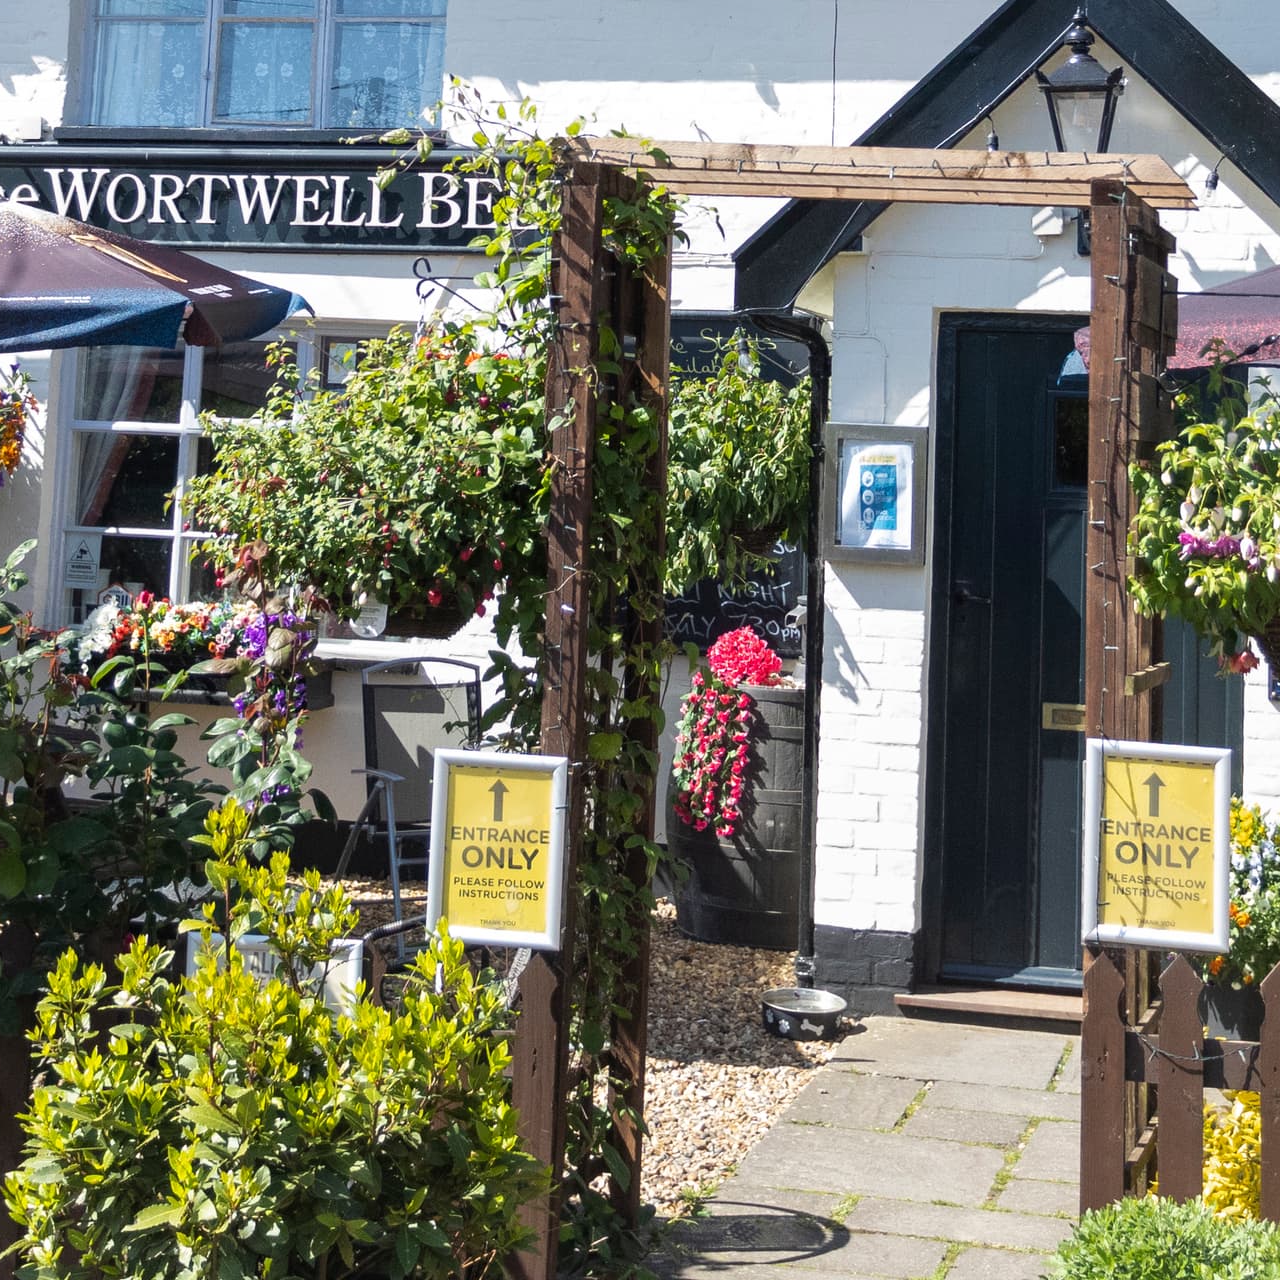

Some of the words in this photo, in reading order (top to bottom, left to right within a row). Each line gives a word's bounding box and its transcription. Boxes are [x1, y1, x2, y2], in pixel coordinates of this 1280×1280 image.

[44, 168, 405, 227] WORTWELL
[450, 826, 550, 844] ENTRANCE
[1103, 820, 1211, 842] ENTRANCE
[462, 845, 539, 870] ONLY
[1115, 840, 1199, 869] ONLY
[453, 876, 494, 887] PLEASE
[498, 879, 545, 889] FOLLOW
[1106, 872, 1151, 885] PLEASE
[1156, 877, 1207, 889] FOLLOW
[459, 889, 539, 901] INSTRUCTIONS
[1112, 886, 1200, 902] INSTRUCTIONS
